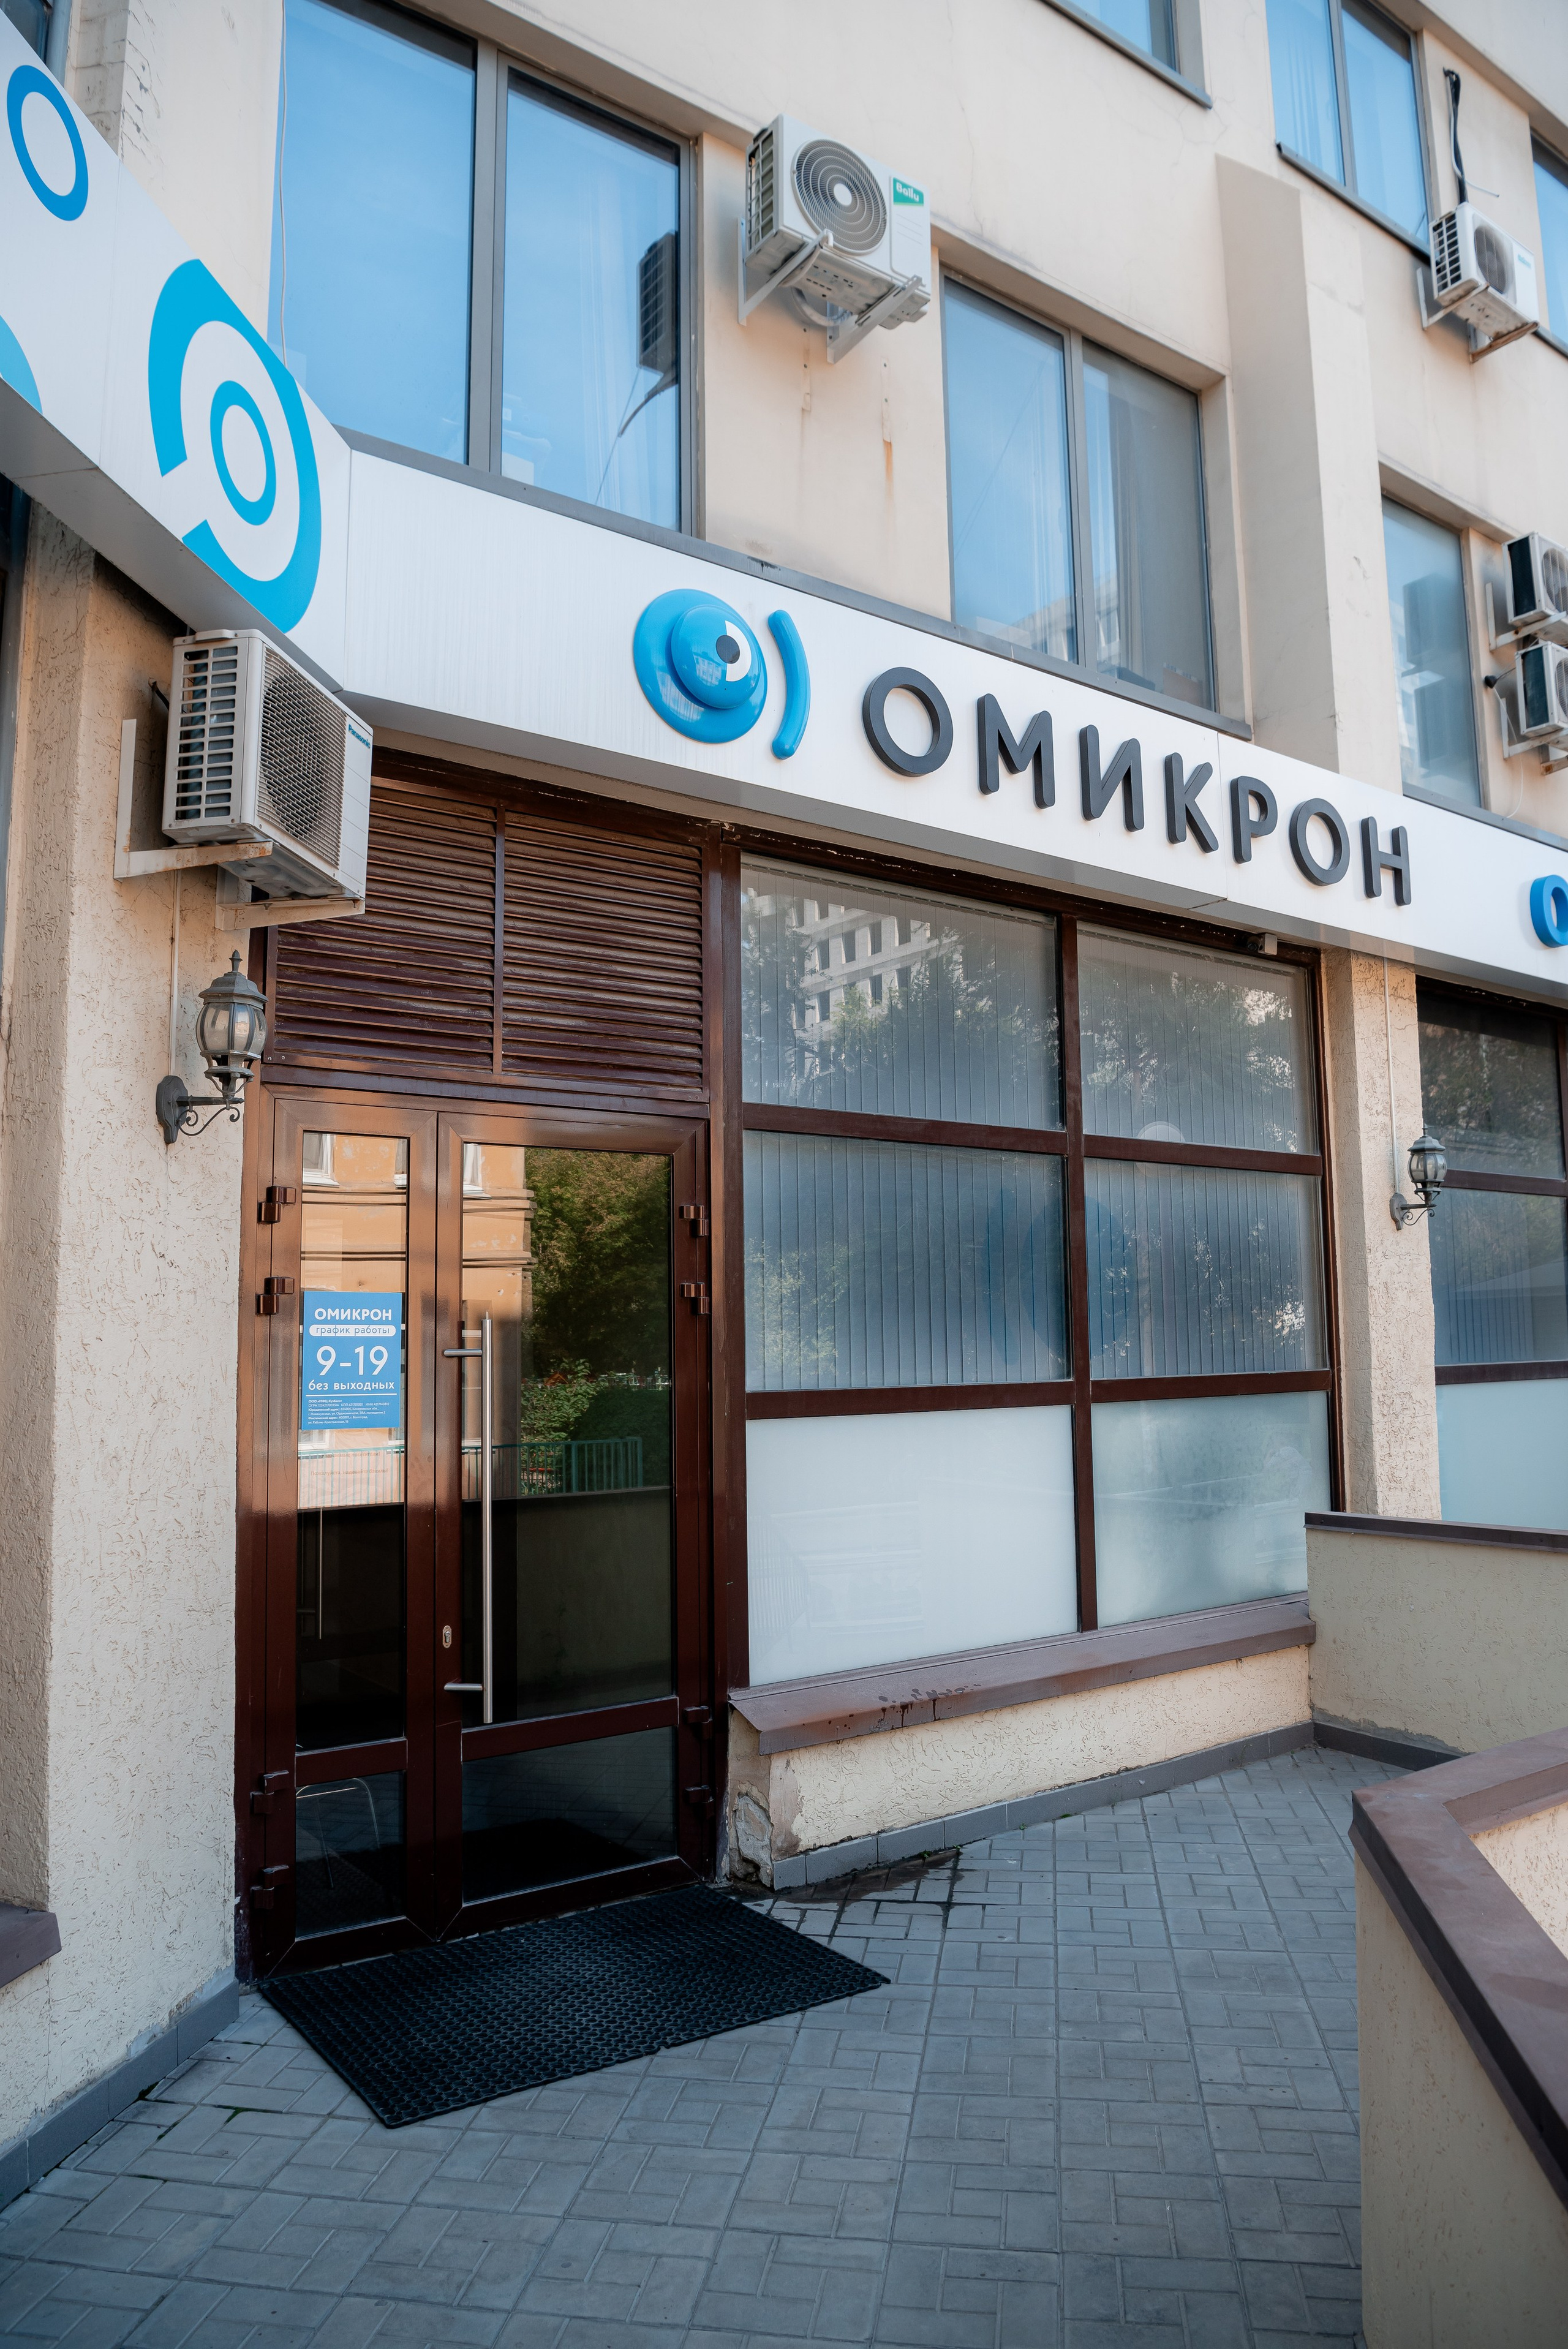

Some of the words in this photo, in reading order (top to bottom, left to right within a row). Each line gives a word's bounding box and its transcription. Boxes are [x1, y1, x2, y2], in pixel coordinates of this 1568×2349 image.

[896, 181, 919, 202] Ballu
[349, 723, 371, 749] Panasonic
[862, 666, 1412, 907] ОМИКРОН
[314, 1308, 392, 1321] ОМИКРОН
[316, 1325, 350, 1336] график
[354, 1325, 390, 1336] работы
[317, 1345, 388, 1376] 9-19
[308, 1379, 328, 1390] без
[334, 1382, 394, 1390] выходных
